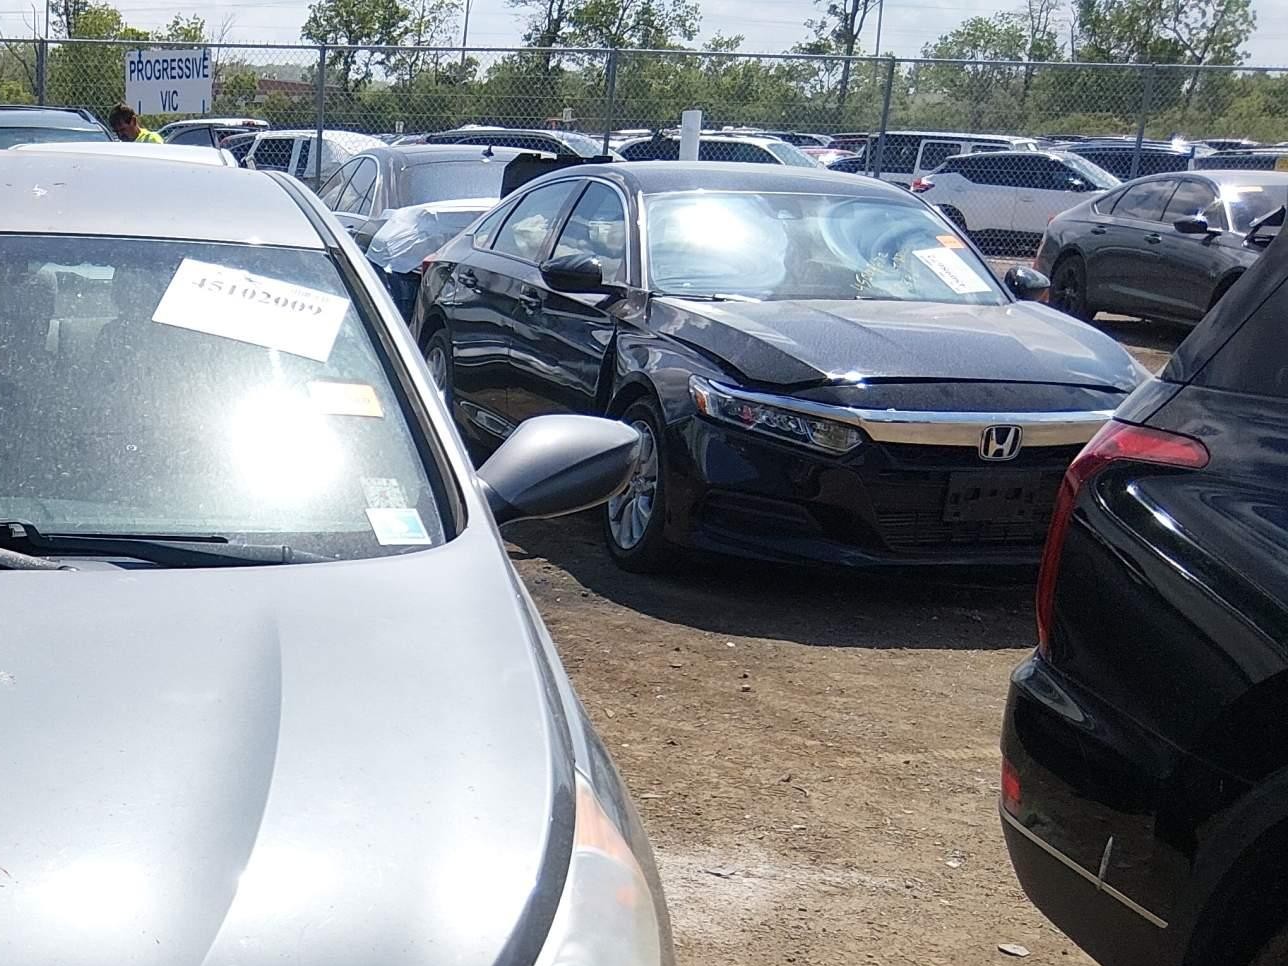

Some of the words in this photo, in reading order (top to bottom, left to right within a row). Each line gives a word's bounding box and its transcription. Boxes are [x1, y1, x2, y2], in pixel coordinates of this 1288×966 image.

[129, 57, 209, 81] PROGRESSIVE
[160, 90, 179, 111] VIC
[193, 277, 323, 316] 45102009
